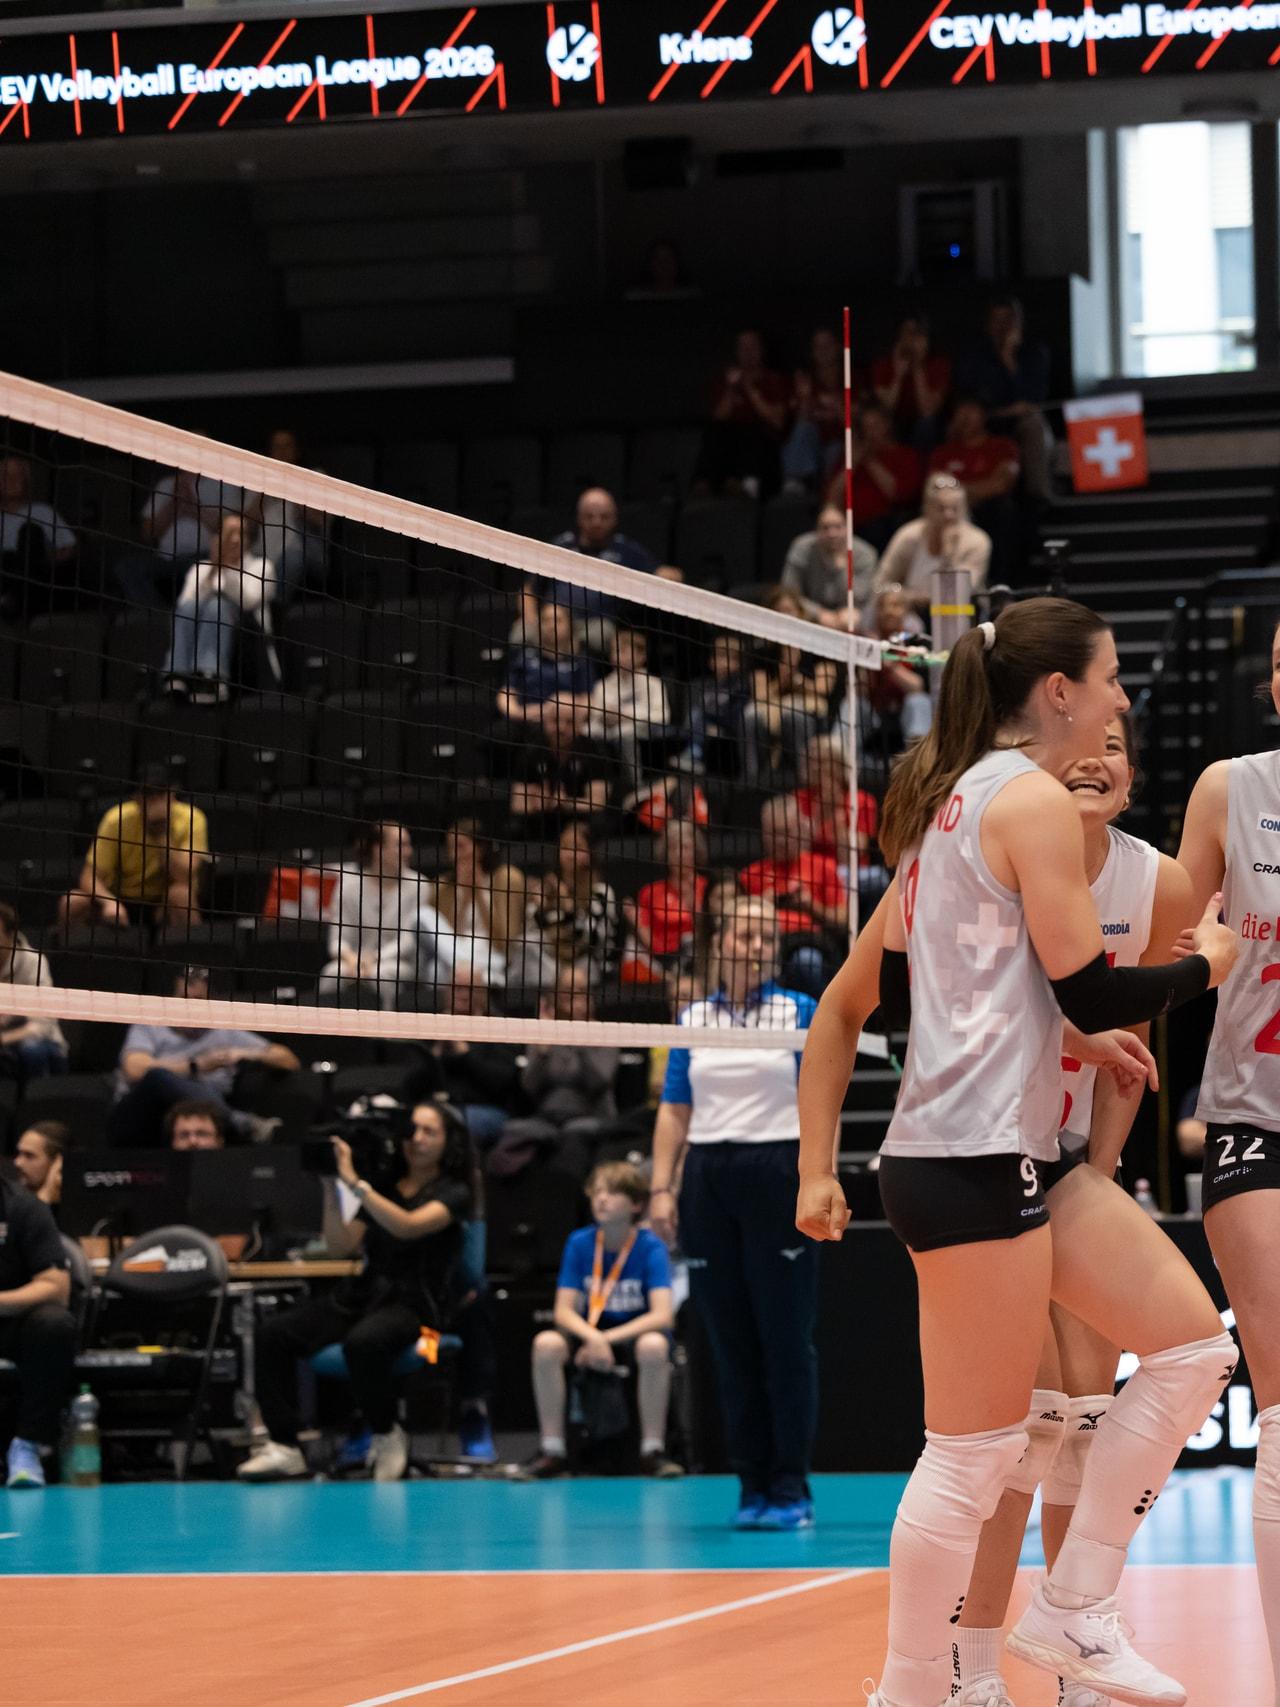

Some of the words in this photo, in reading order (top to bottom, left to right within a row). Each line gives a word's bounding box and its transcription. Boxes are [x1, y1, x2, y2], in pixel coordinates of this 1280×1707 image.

[928, 14, 994, 49] CEV
[995, 3, 1142, 48] Volleyball
[0, 75, 37, 105] EV
[39, 62, 176, 105] Volleyball
[179, 63, 313, 97] European
[315, 54, 421, 89] League
[424, 45, 496, 79] 2026
[1241, 912, 1272, 941] die
[1216, 1134, 1266, 1167] 22
[1020, 1156, 1038, 1197] 9
[1213, 1168, 1241, 1184] CRAFT
